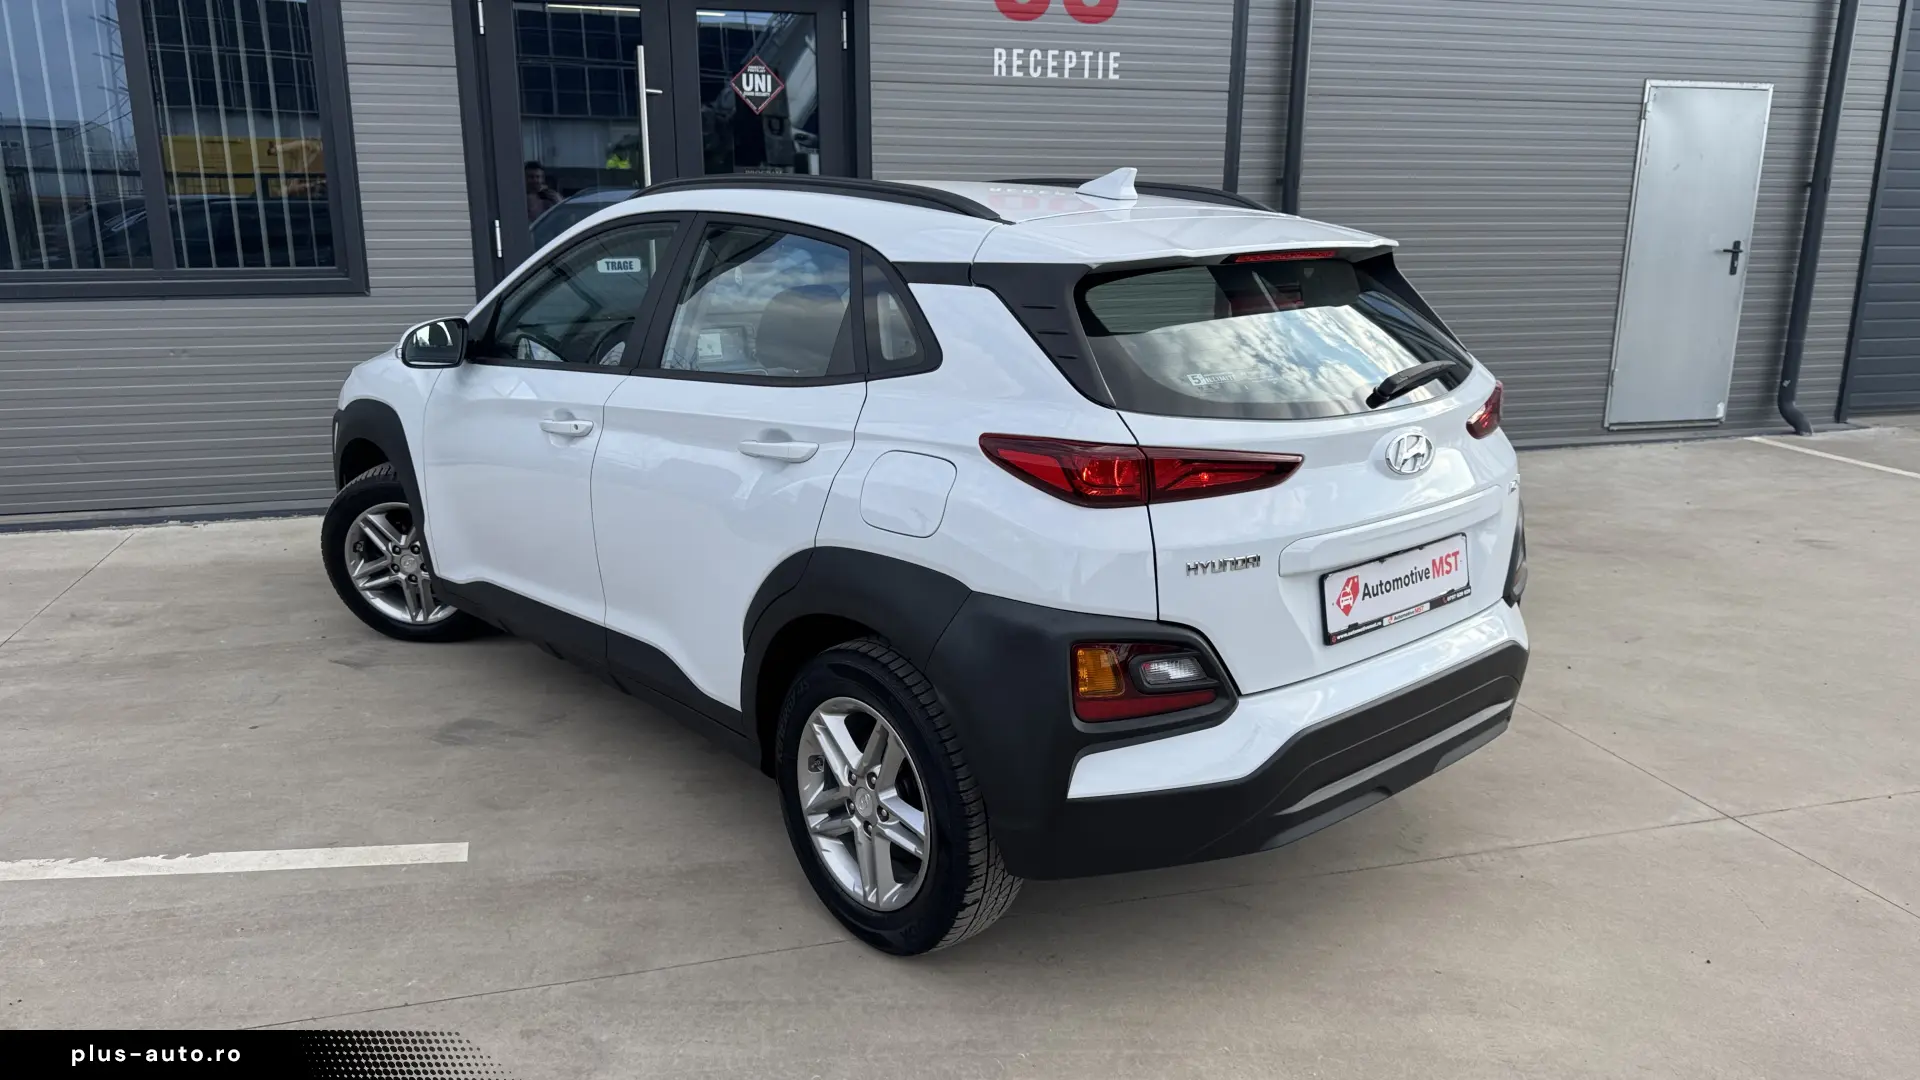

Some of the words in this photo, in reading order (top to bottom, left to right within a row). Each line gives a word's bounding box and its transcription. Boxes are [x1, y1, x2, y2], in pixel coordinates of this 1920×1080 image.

[993, 48, 1121, 80] RECEPTIE
[741, 73, 772, 93] UNI
[604, 260, 634, 271] TRAGE
[1186, 554, 1260, 577] HYUNDAI
